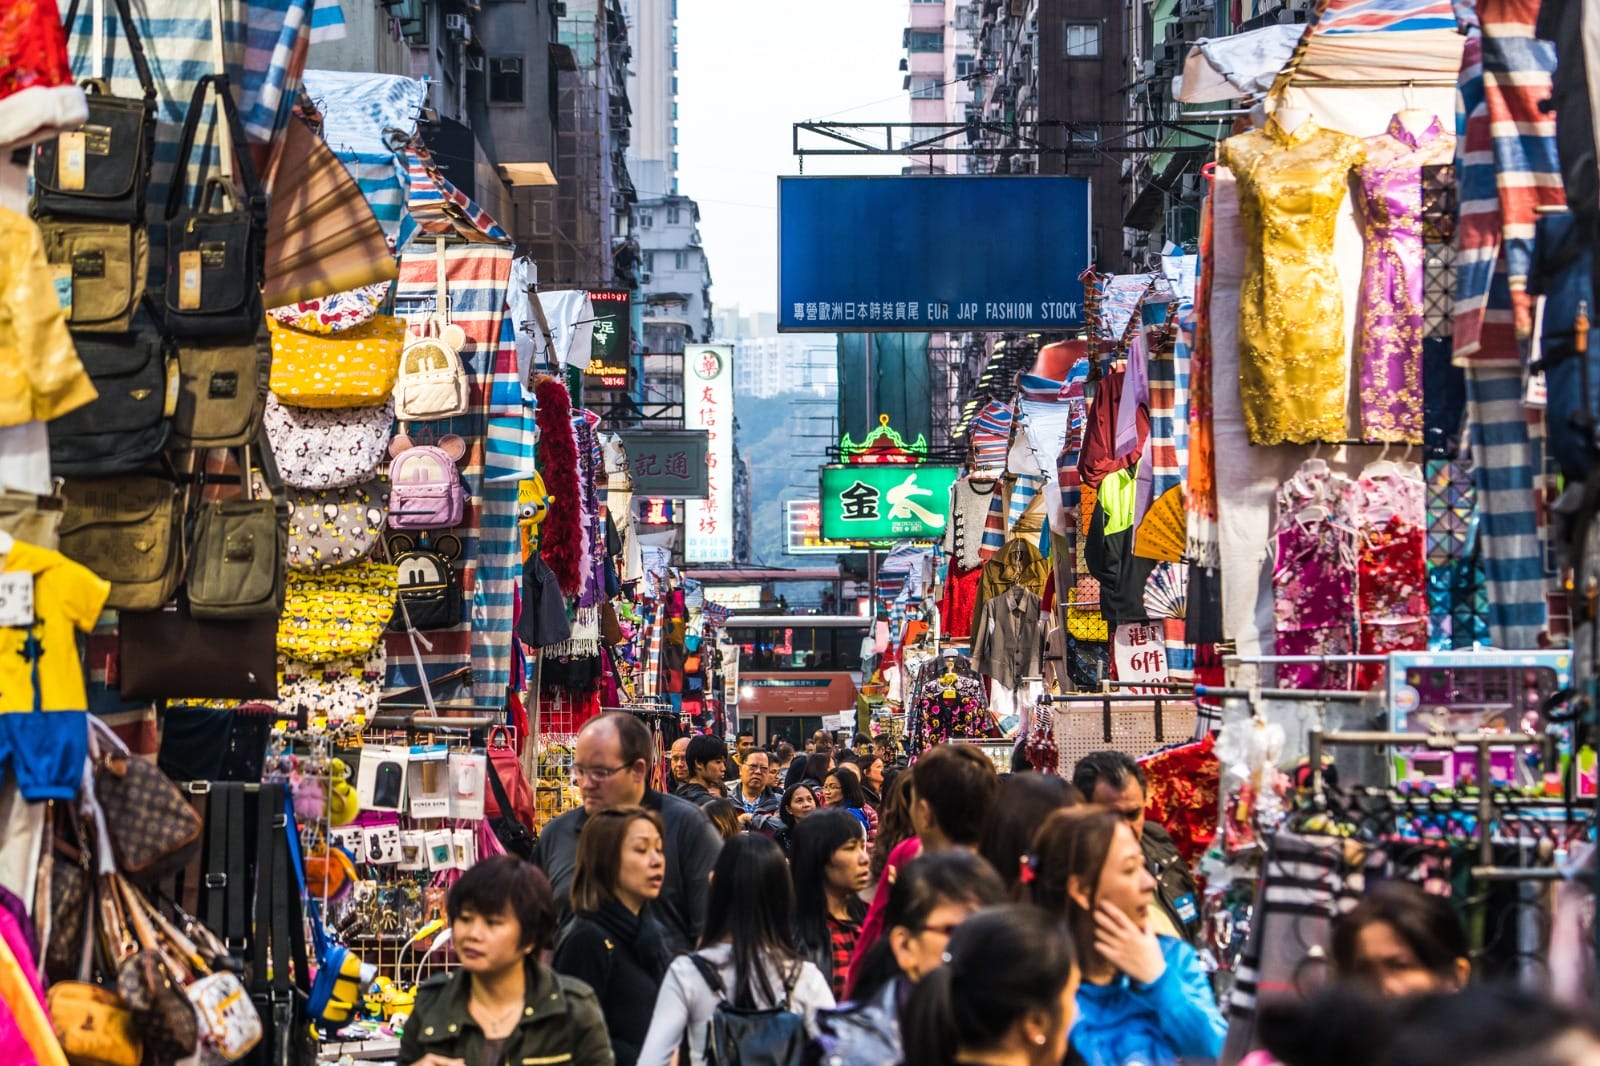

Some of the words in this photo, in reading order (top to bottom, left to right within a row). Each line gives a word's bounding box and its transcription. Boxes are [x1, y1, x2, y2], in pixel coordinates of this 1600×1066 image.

[793, 302, 919, 321] 專營歐洲日本時裝貨尾
[928, 302, 949, 321] EUR
[957, 302, 978, 321] JAP
[985, 302, 1033, 320] FASHION
[1041, 302, 1077, 320] STOCK
[1130, 650, 1165, 674] 6件
